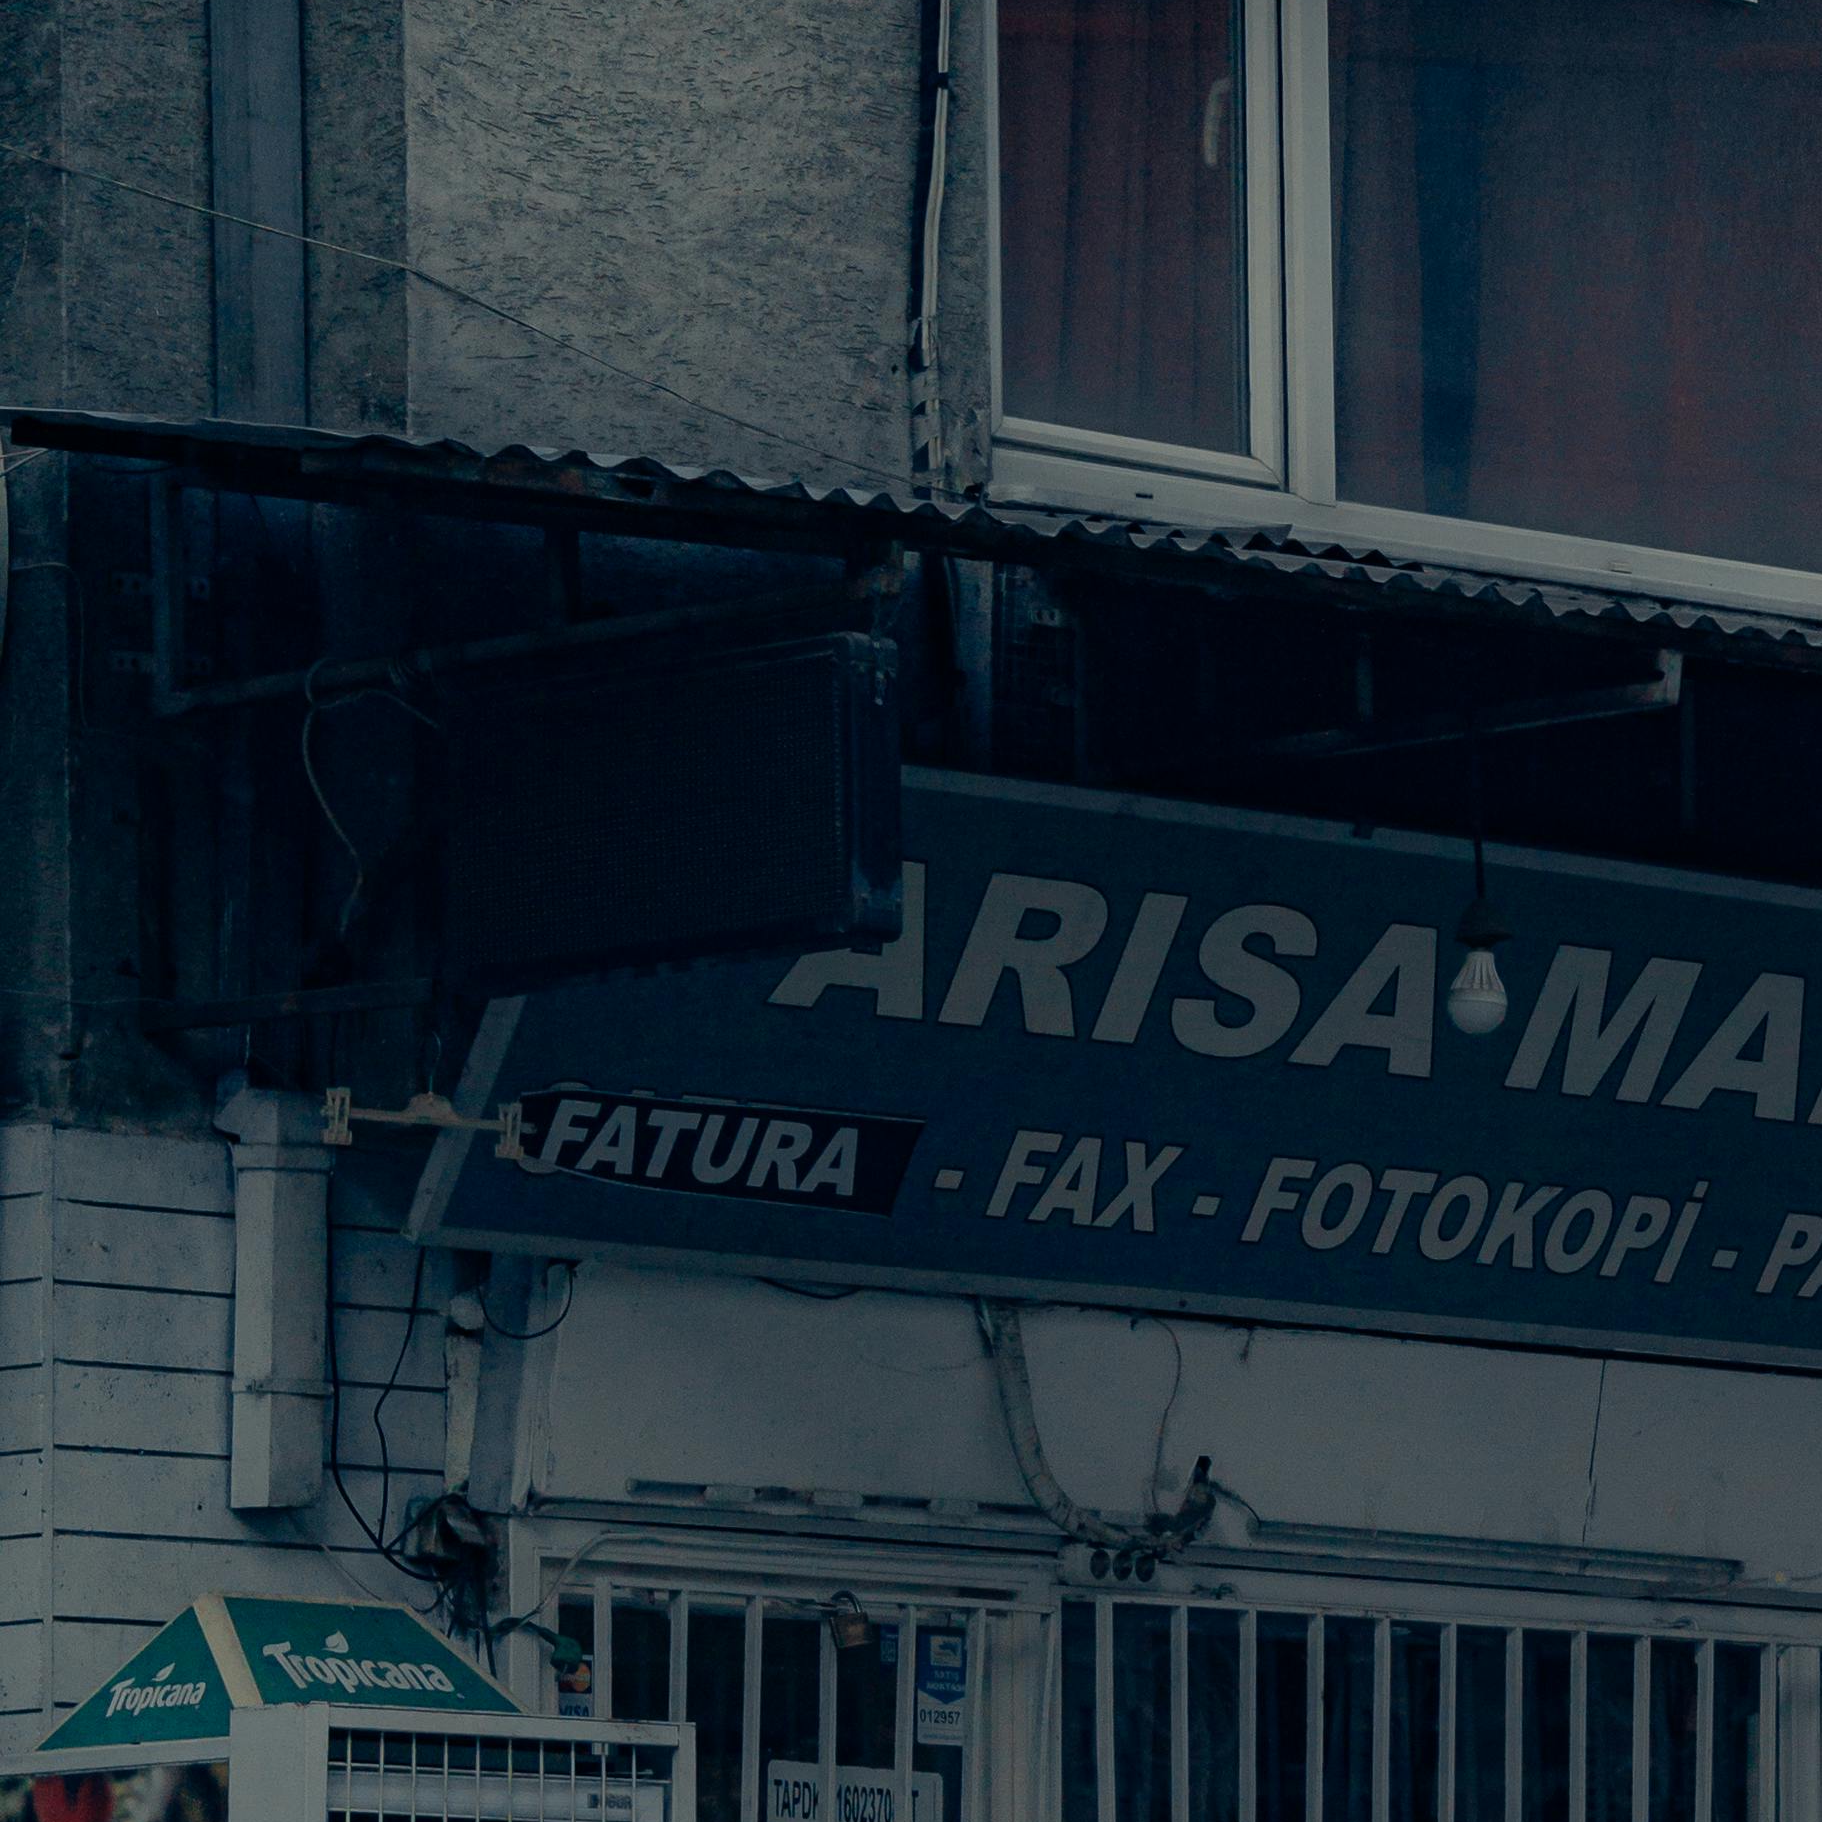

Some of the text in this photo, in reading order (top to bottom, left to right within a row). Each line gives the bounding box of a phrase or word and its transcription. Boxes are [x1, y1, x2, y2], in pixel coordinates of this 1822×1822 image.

[540, 1098, 860, 1197] FATURA
[985, 1128, 1184, 1235] FAX
[1239, 1156, 1710, 1285] FOTOKOPİ
[262, 1640, 456, 1694] Tropicana
[105, 1676, 207, 1719] Tropicana
[919, 1708, 961, 1725] 012957
